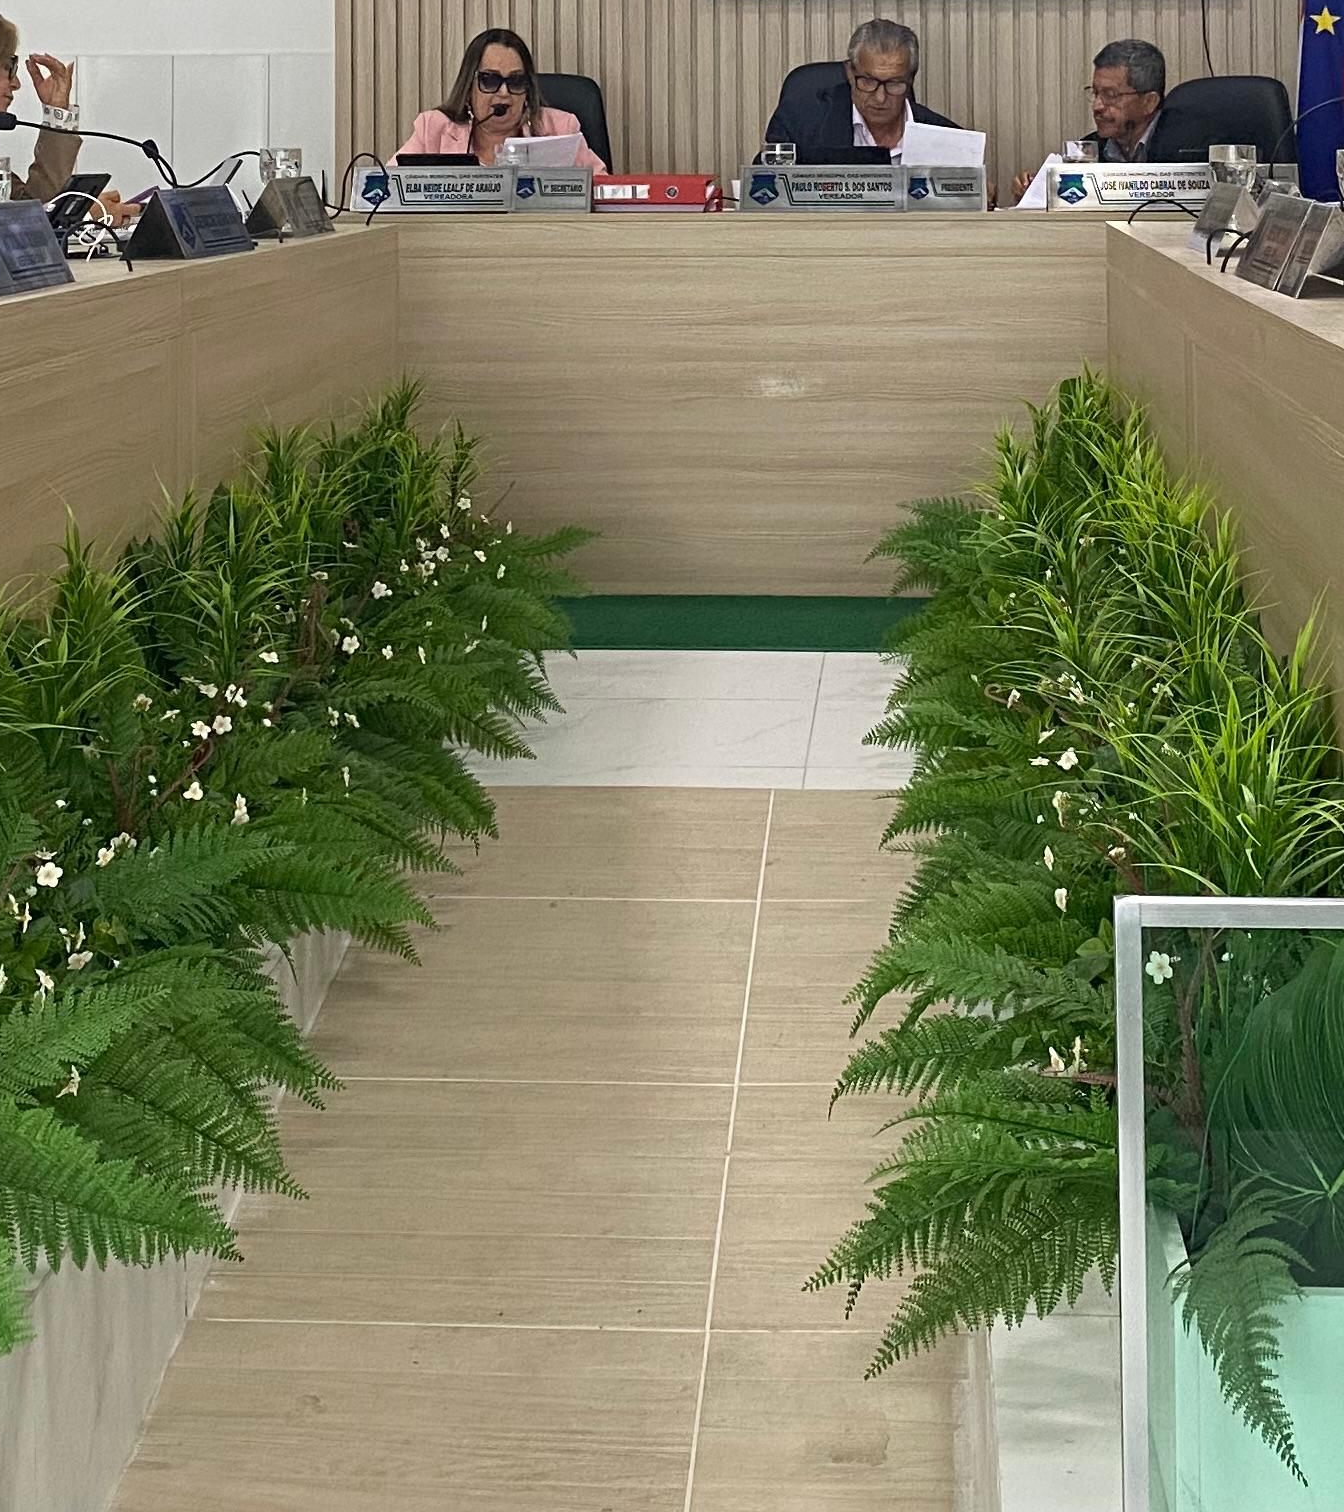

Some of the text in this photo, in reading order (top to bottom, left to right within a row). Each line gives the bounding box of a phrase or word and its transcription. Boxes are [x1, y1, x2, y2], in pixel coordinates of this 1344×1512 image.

[405, 183, 422, 193] ELBA
[423, 183, 443, 193] NEIDE
[465, 183, 474, 192] DE
[791, 181, 813, 192] PAULO
[813, 181, 844, 192] ROBERTO
[852, 181, 866, 192] DOS
[866, 181, 893, 192] SANTOS
[1118, 181, 1149, 191] IVANILDO
[1150, 180, 1177, 190] CABRAL
[1177, 180, 1187, 190] DE
[1187, 179, 1211, 190] SOUZA
